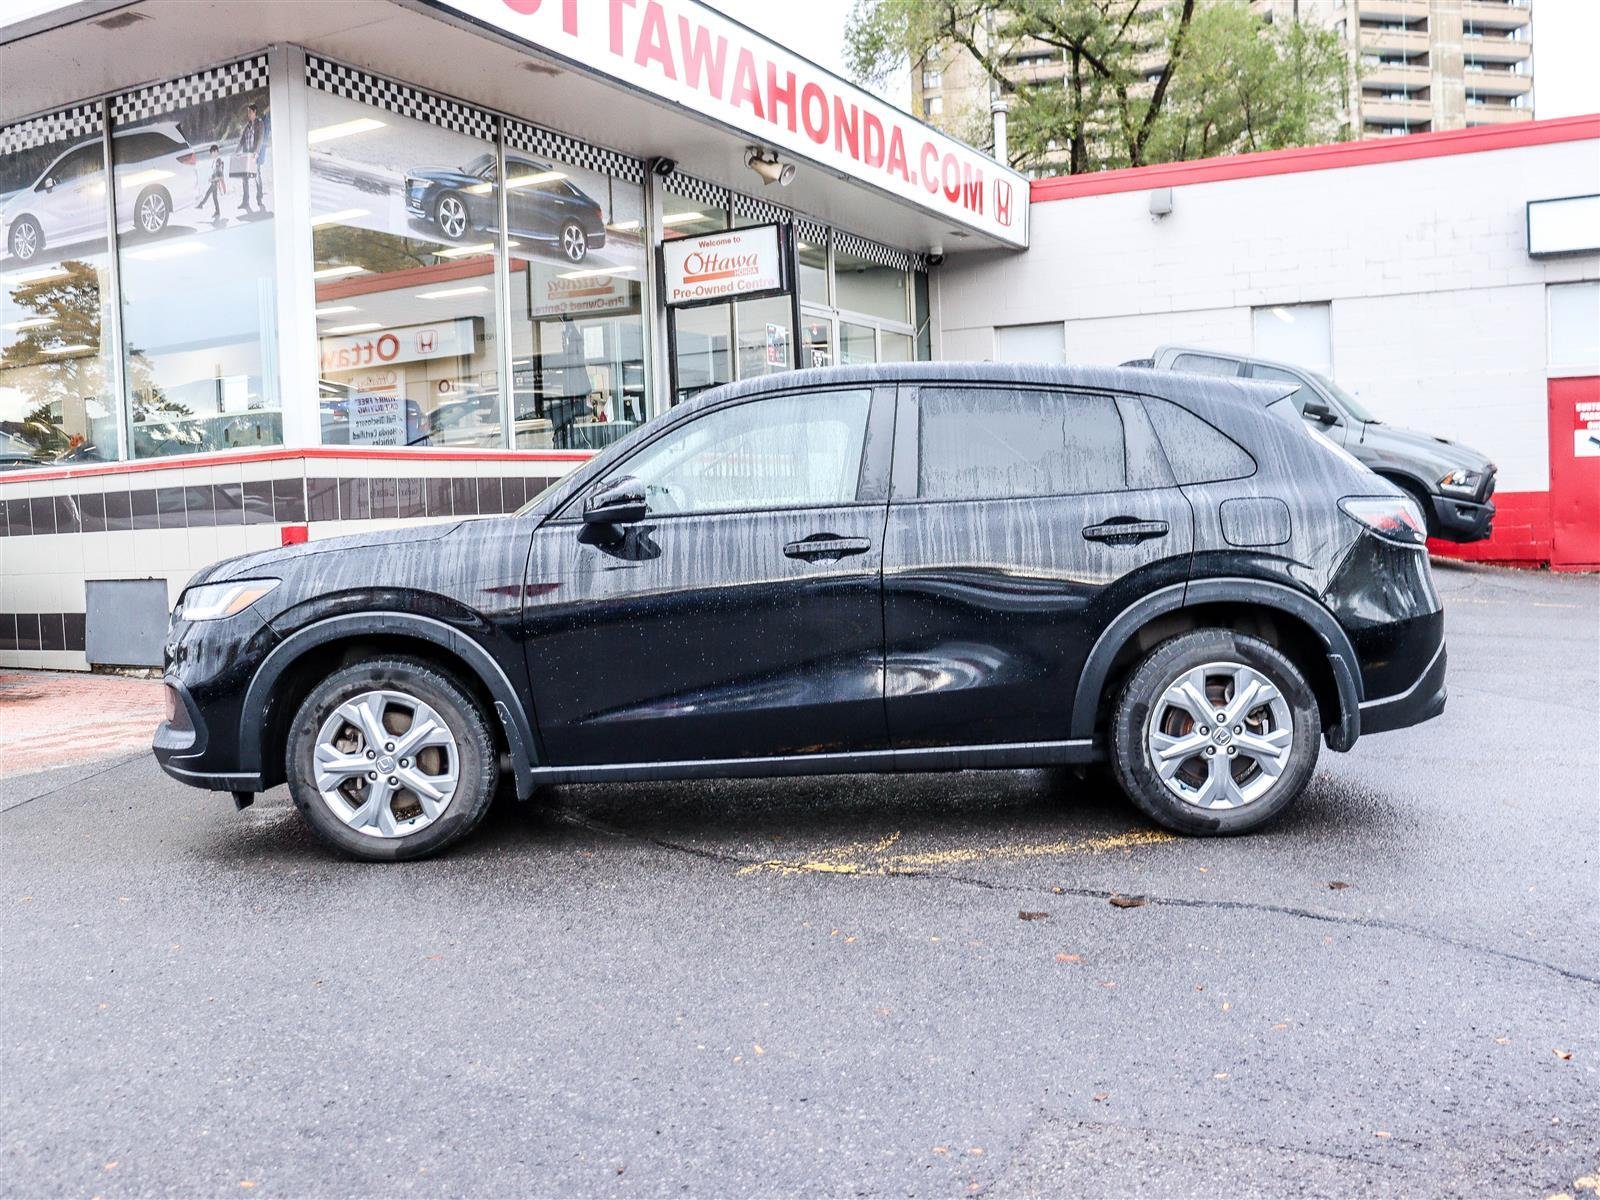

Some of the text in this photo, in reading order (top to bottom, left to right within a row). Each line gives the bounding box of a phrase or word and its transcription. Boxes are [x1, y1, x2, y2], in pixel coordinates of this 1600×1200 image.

[699, 236, 741, 249] Welcome to
[683, 251, 759, 275] Ottawa
[673, 278, 775, 299] Pre-Owned Centre
